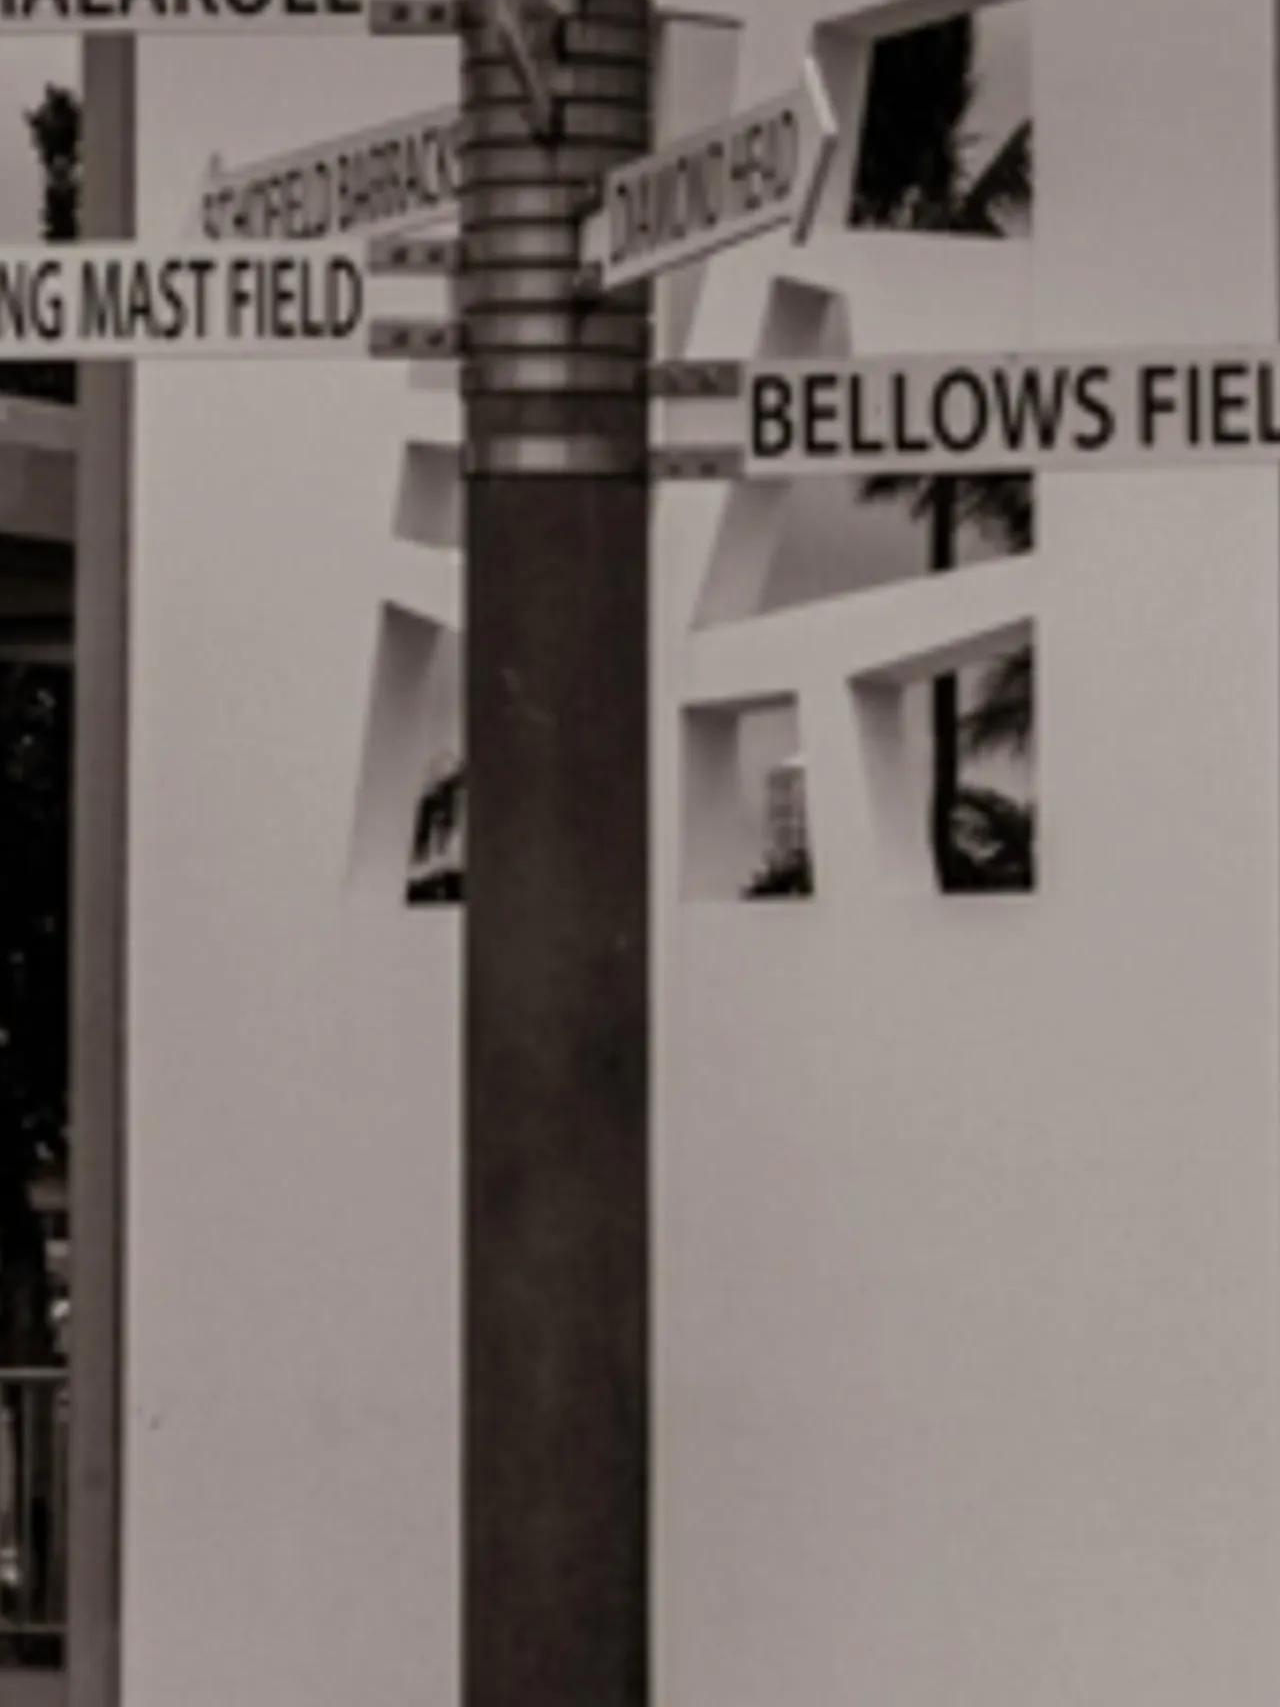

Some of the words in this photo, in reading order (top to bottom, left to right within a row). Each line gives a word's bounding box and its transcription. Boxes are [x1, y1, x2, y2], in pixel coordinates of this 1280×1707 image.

[80, 257, 216, 342] MAST
[226, 254, 365, 341] FIELD
[749, 365, 1116, 460] BELLOWS
